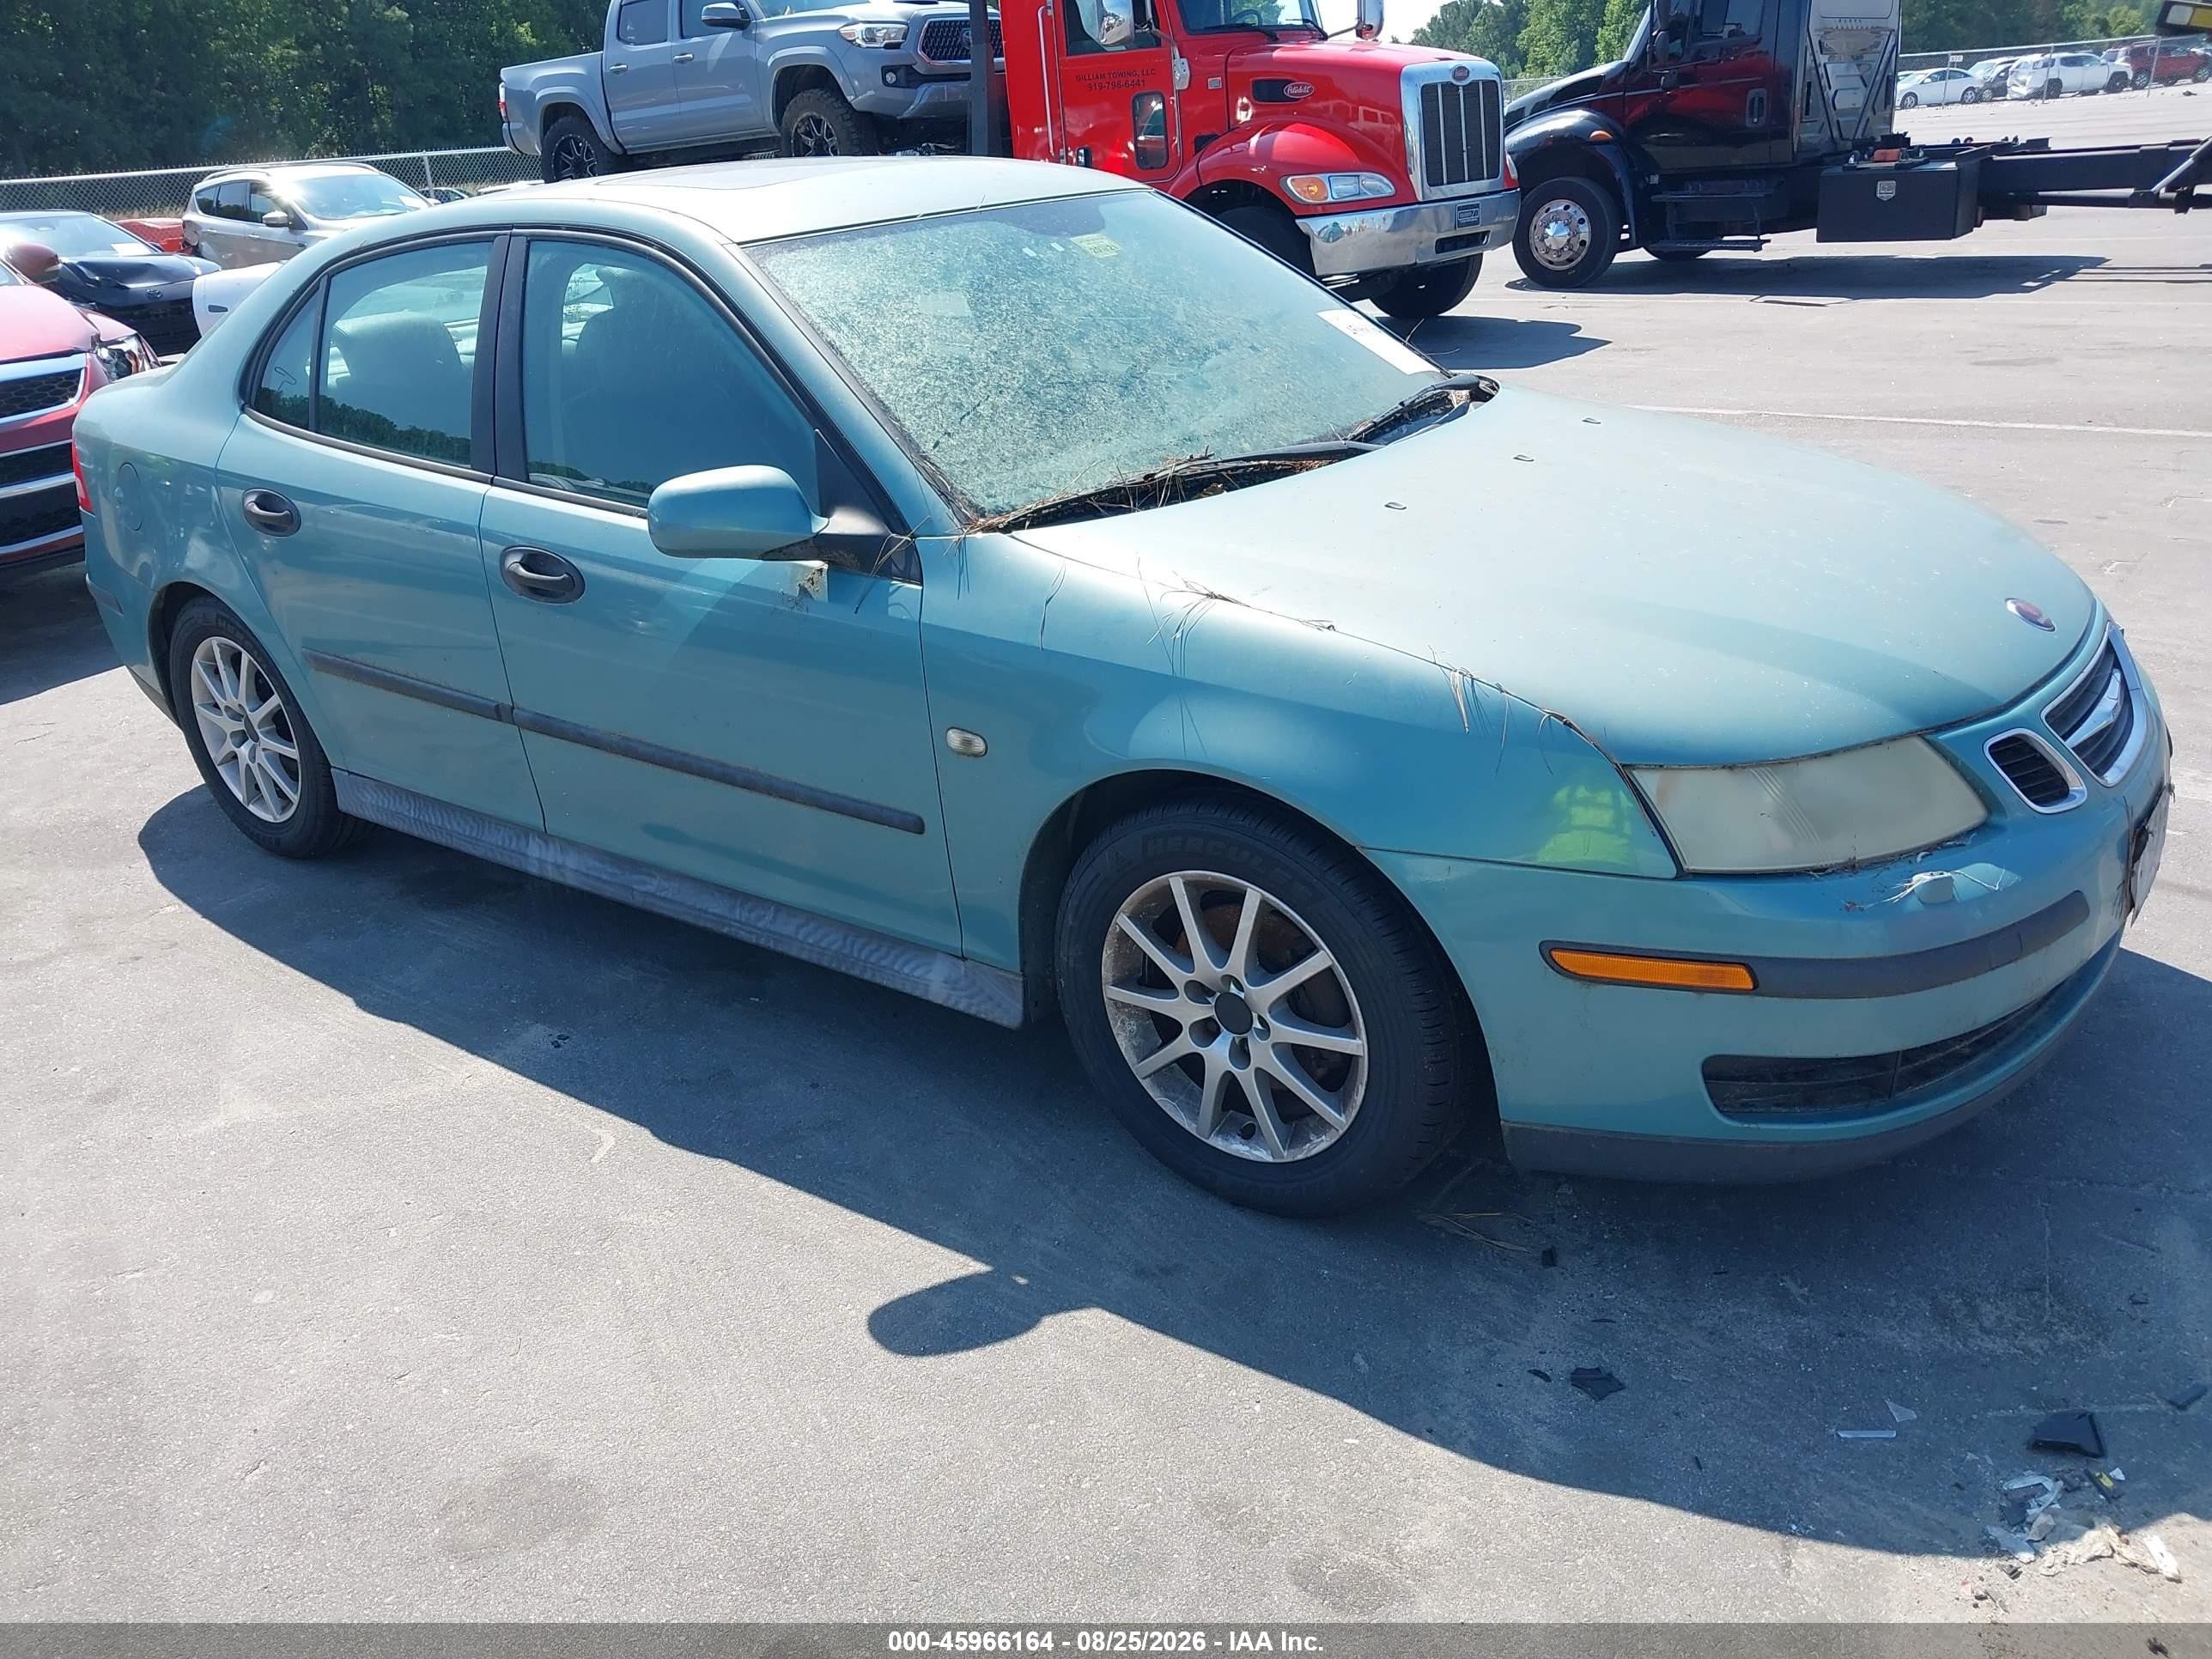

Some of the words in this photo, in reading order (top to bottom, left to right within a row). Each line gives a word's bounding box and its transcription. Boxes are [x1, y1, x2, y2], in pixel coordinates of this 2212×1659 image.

[1075, 72, 1106, 82] GILLIAM
[1108, 69, 1139, 78] TOWING,
[1142, 68, 1155, 76] LLC
